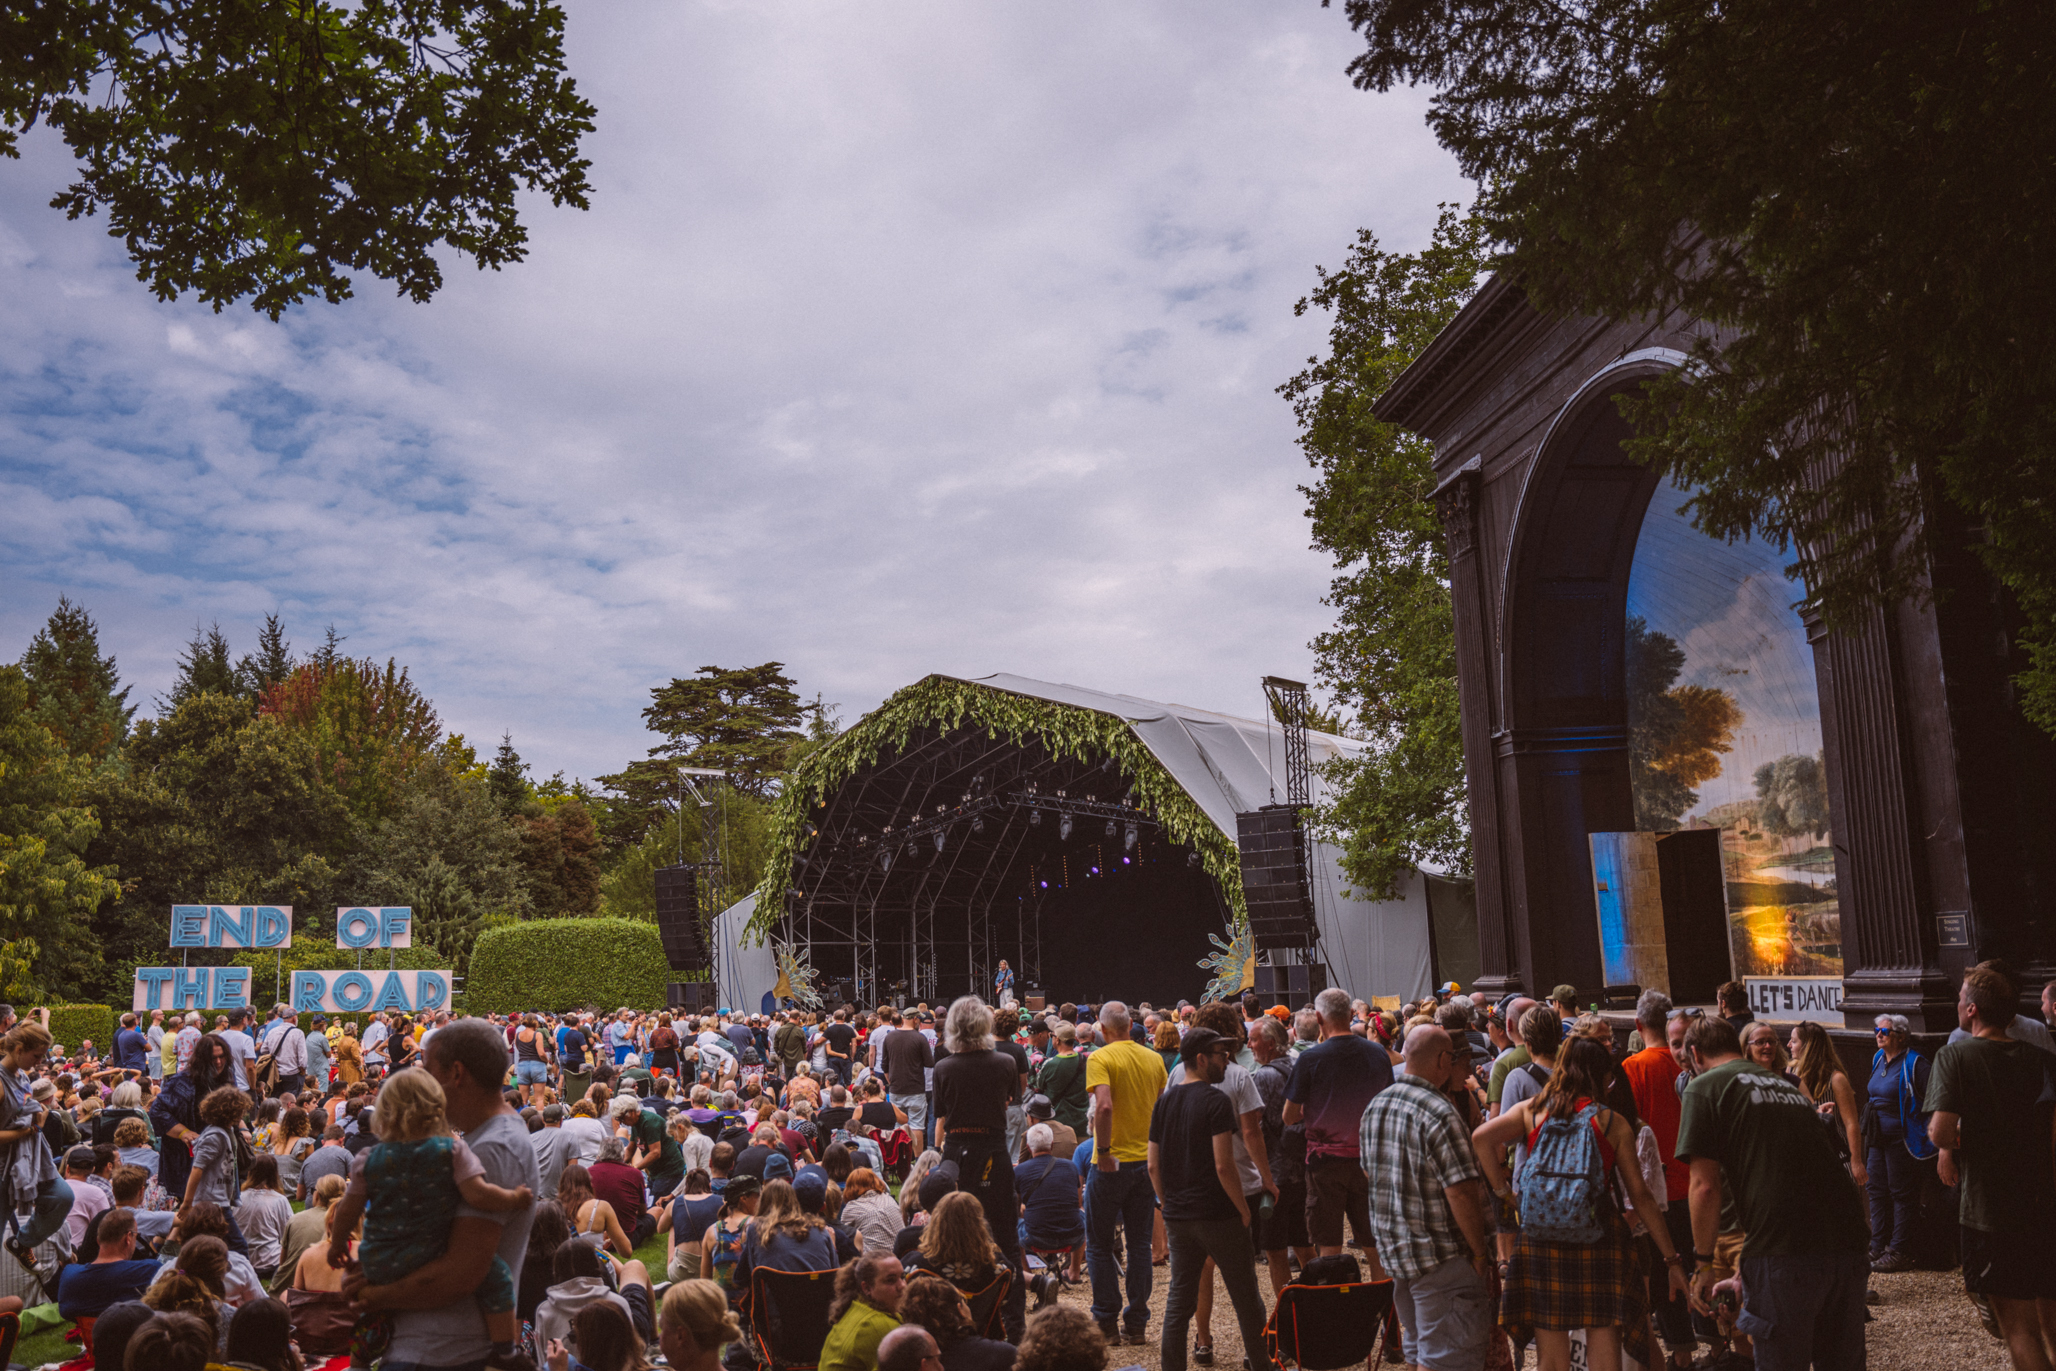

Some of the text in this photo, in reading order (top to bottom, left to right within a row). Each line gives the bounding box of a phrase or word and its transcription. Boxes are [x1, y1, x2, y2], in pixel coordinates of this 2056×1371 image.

[171, 905, 411, 948] END OF
[138, 968, 448, 1012] THE ROAD
[1750, 984, 1841, 1014] LET'S DANCE
